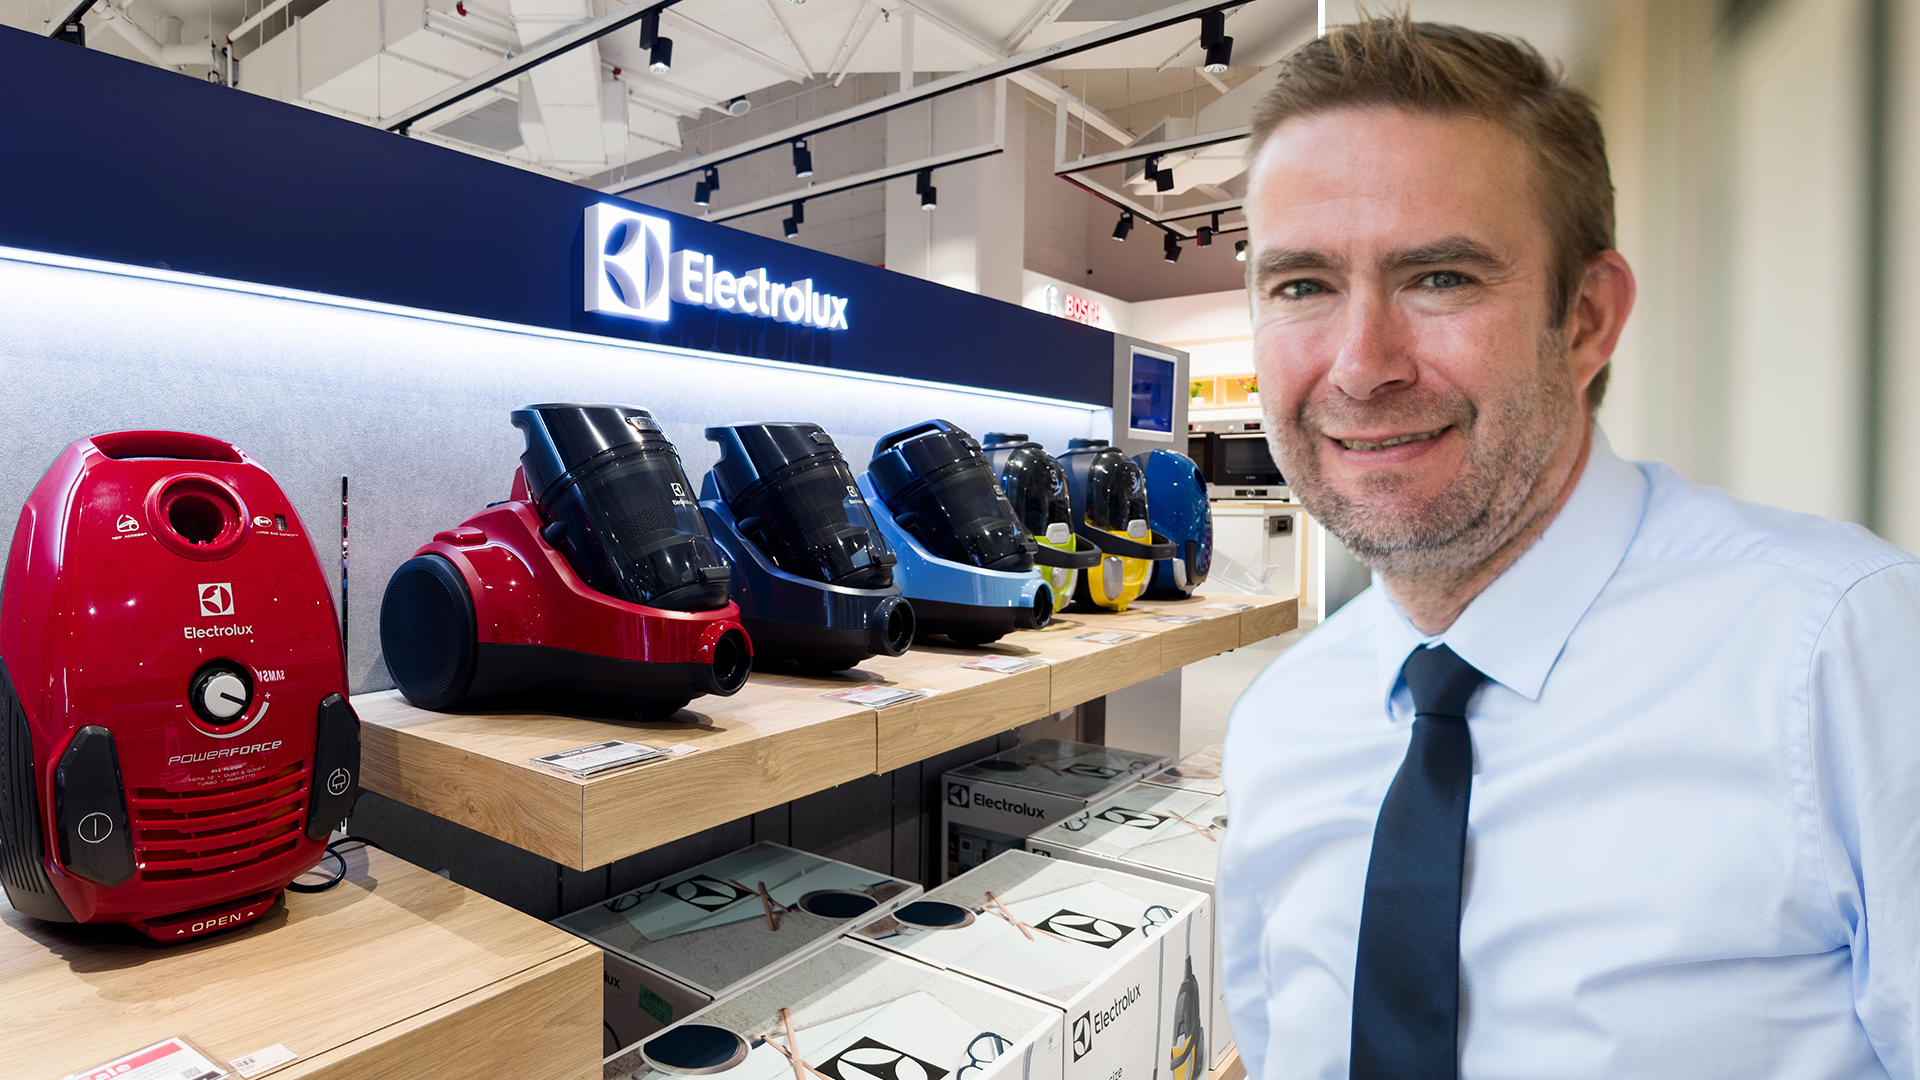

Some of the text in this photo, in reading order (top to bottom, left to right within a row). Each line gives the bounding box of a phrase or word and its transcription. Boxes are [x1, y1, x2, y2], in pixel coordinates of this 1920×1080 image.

[681, 249, 848, 330] Electrolux
[1065, 294, 1103, 324] BOSCH
[183, 624, 254, 639] Electrolux
[973, 793, 1045, 819] Electrolux
[191, 912, 242, 932] OPEN
[1094, 983, 1142, 1035] Electrolux
[79, 1064, 132, 1080] ale
